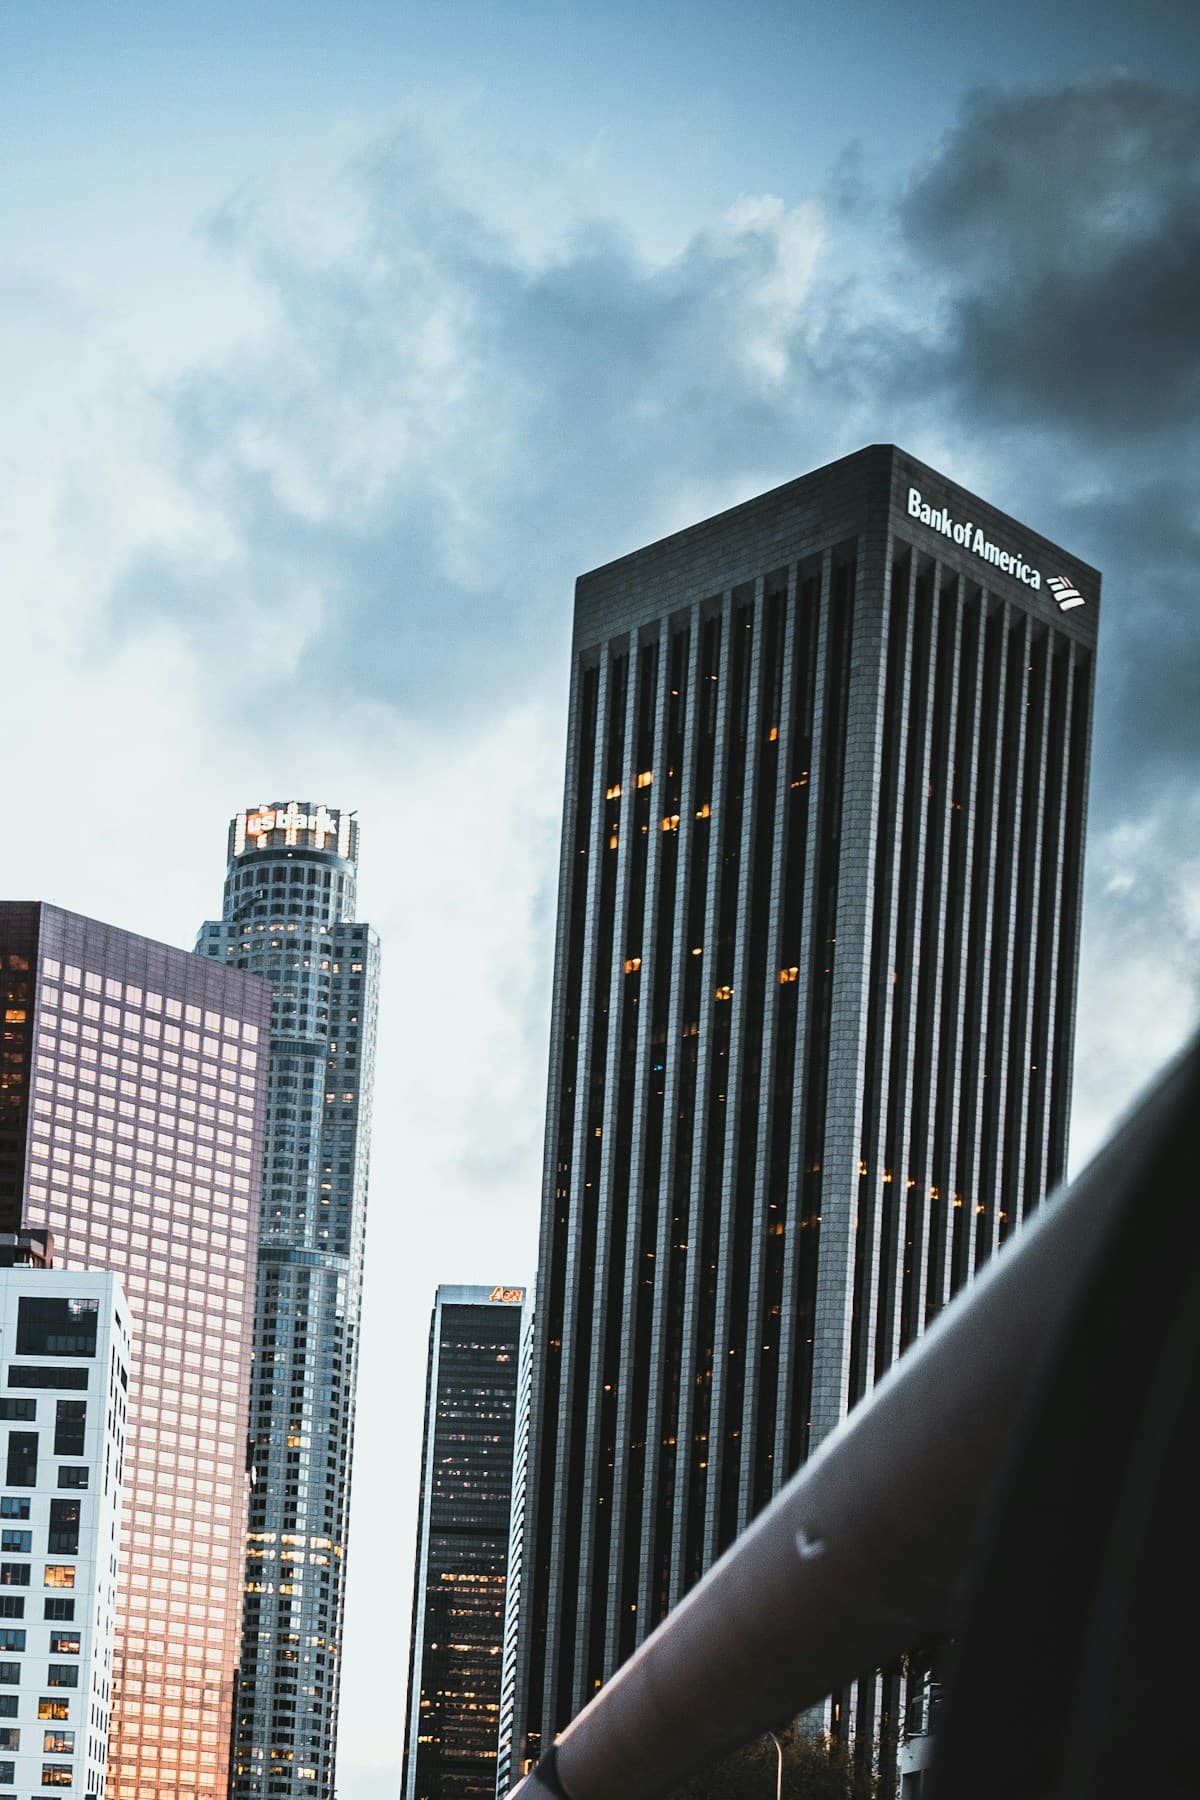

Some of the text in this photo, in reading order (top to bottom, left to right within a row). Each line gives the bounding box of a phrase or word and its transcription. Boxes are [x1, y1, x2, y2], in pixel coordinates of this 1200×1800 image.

[907, 487, 1041, 590] Bank of America
[247, 809, 338, 834] us bank
